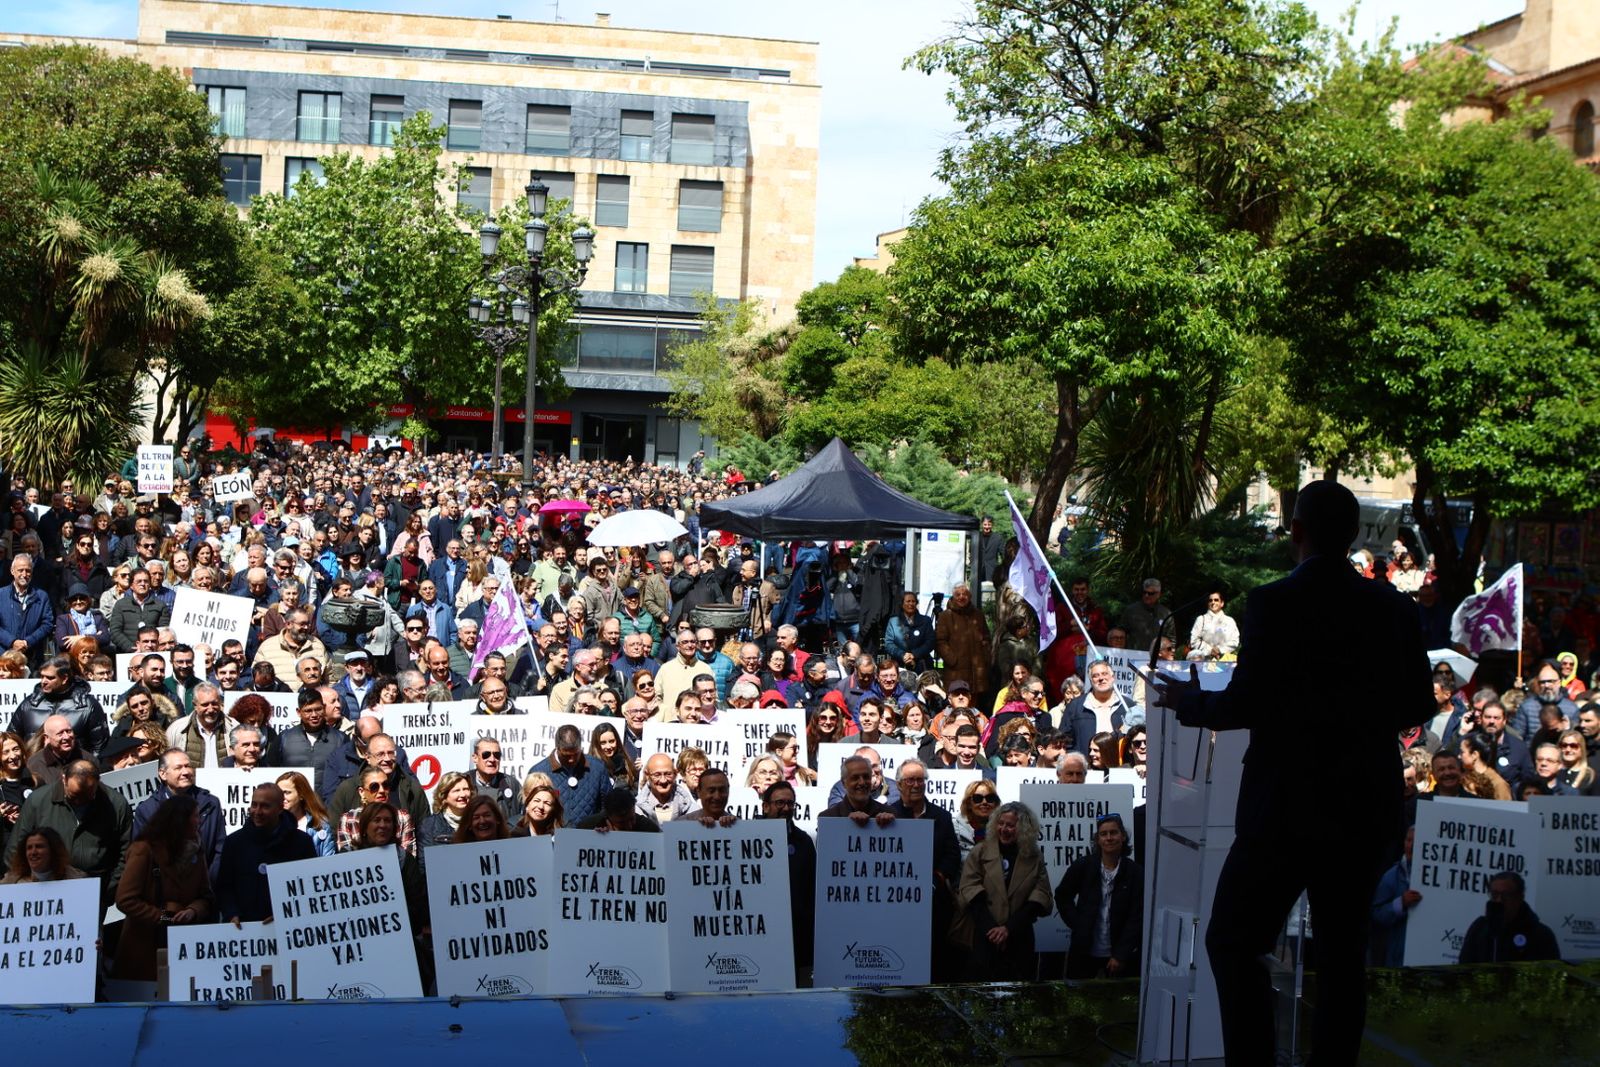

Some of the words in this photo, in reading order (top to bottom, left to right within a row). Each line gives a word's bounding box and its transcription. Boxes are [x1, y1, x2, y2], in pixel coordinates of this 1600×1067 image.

[450, 409, 483, 418] Santander
[214, 476, 251, 495] LEÓN
[1365, 523, 1387, 540] TV
[207, 600, 221, 614] NI
[184, 612, 237, 632] AISLADOS
[201, 631, 214, 644] NI
[403, 713, 437, 728] TRENES
[440, 711, 452, 727] SÍ,
[391, 733, 450, 748] ISLAMIENTO
[454, 732, 465, 745] NO
[477, 728, 528, 743] SALAMA
[656, 738, 689, 753] TREN
[1042, 801, 1109, 818] PORTUGAL
[1552, 813, 1599, 831] BARCE
[1068, 824, 1084, 841] AL
[1439, 821, 1516, 848] PORTUGAL
[678, 840, 732, 860] RENFE
[741, 838, 774, 859] NOS
[848, 835, 862, 852] LA
[869, 836, 904, 853] RUTA
[1575, 836, 1600, 853] SIN
[480, 851, 500, 876] NI
[578, 848, 656, 870] PORTUGAL
[1422, 842, 1458, 863] ESTÁ
[1466, 849, 1483, 867] AL
[1490, 851, 1528, 876] LADO,
[1547, 858, 1600, 877] TRASBO
[287, 874, 305, 897] NI
[313, 865, 384, 893] EXCUSAS
[692, 865, 731, 886] DEJA
[741, 864, 761, 884] EN
[832, 861, 846, 877] DE
[853, 861, 868, 878] LA
[874, 861, 918, 881] PLATA,
[1422, 865, 1440, 888] EL
[450, 877, 538, 906] AISLADOS
[562, 871, 599, 893] ESTÁ
[606, 875, 624, 894] AL
[631, 876, 666, 896] LADO
[713, 886, 744, 911] VÍA
[827, 886, 859, 903] PARA
[867, 886, 881, 903] EL
[887, 886, 921, 903] 2040
[23, 899, 64, 917] RUTA
[283, 900, 300, 918] NI
[485, 906, 506, 929] NI
[562, 897, 581, 920] EL
[591, 899, 636, 922] TREN
[646, 900, 668, 923] NO
[4, 925, 20, 944] LA
[29, 923, 81, 943] PLATA,
[287, 912, 402, 950] ¡CONEXIONES
[694, 914, 766, 937] MUERTA
[179, 943, 187, 960] A
[196, 938, 277, 960] BARCELON
[331, 943, 364, 966] YA!
[448, 929, 549, 961] OLVIDADOS
[19, 951, 35, 968] EL
[43, 947, 84, 966] 2040
[223, 963, 252, 982] SIN
